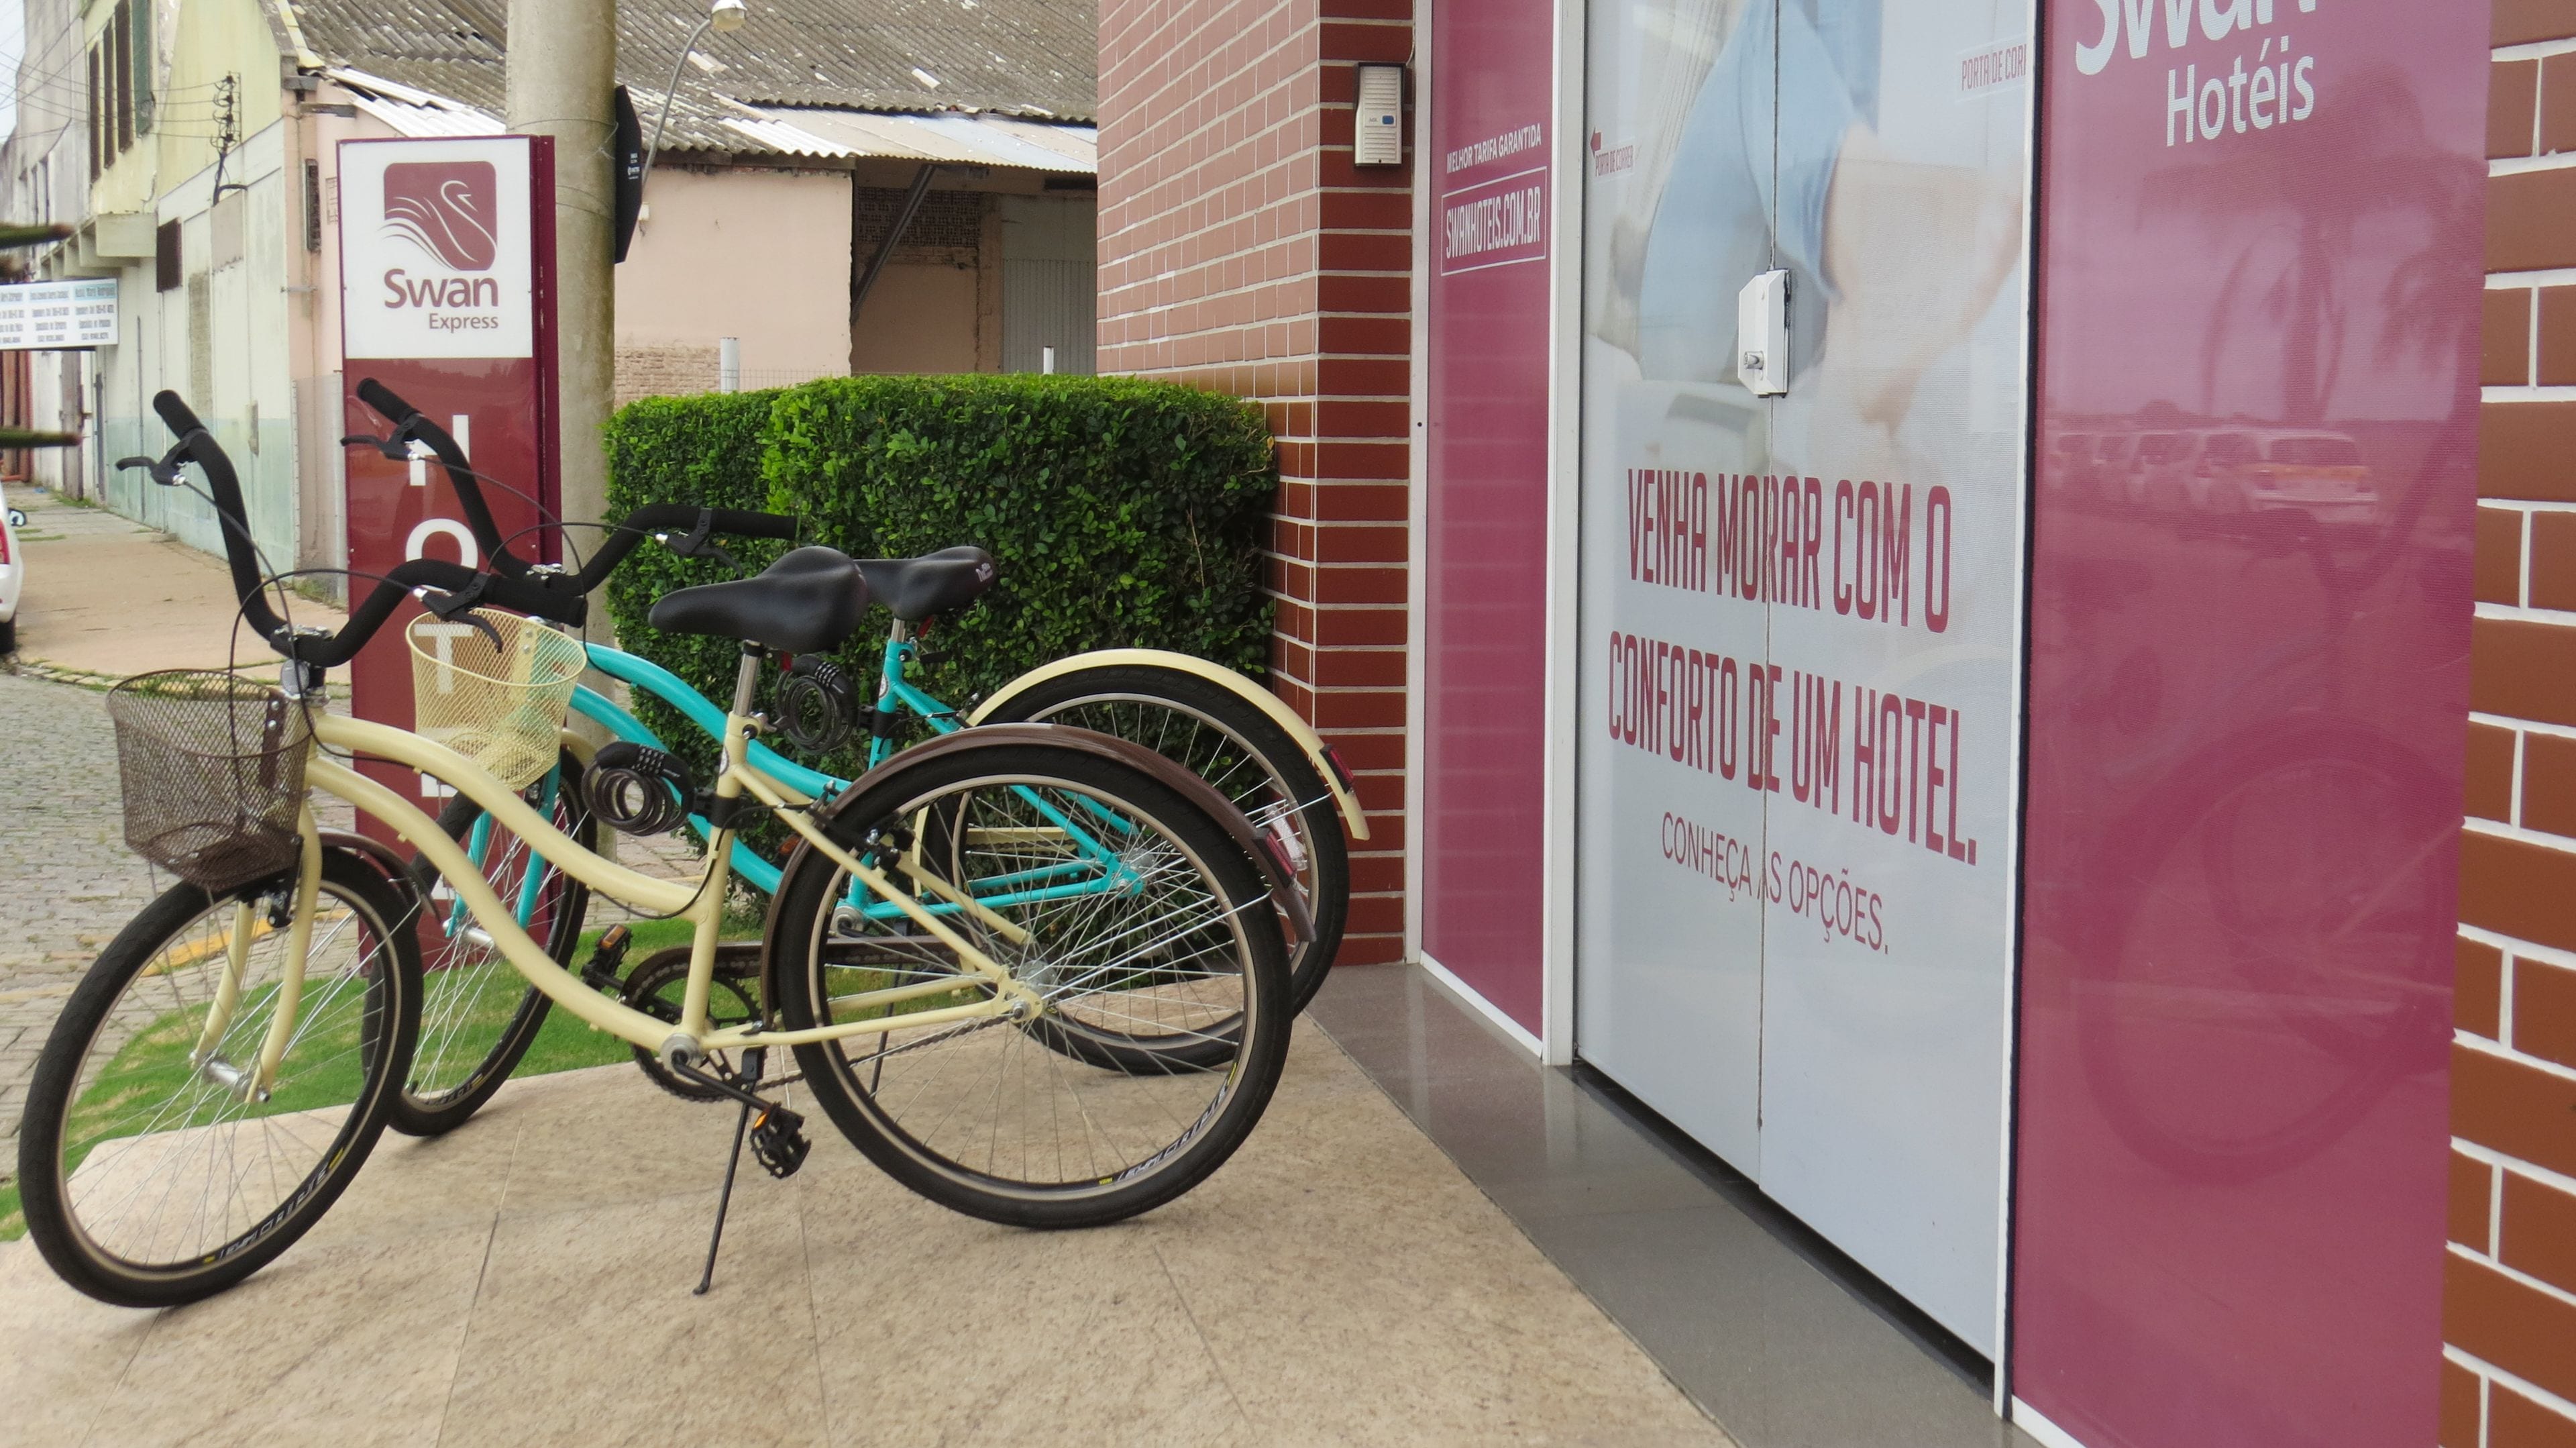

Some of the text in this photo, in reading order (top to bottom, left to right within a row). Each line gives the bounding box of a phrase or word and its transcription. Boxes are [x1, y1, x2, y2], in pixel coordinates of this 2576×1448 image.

[1962, 54, 1990, 92] PORTA
[1992, 50, 2003, 84] DE
[2167, 36, 2314, 147] Hotéis
[1446, 123, 1542, 174] MELHOR TARIFA GARANTIDA
[1446, 186, 1541, 259] SWANHOTEIS.COM.BR
[384, 268, 499, 309] Swan
[429, 313, 499, 333] Express
[1628, 468, 1951, 633] VENHA MORAR COM O
[1609, 631, 1977, 866] CONFORTO DE UM HOTEL.
[1662, 812, 1752, 902] CONHEÇA
[1788, 860, 1888, 955] OPÇÕES.
